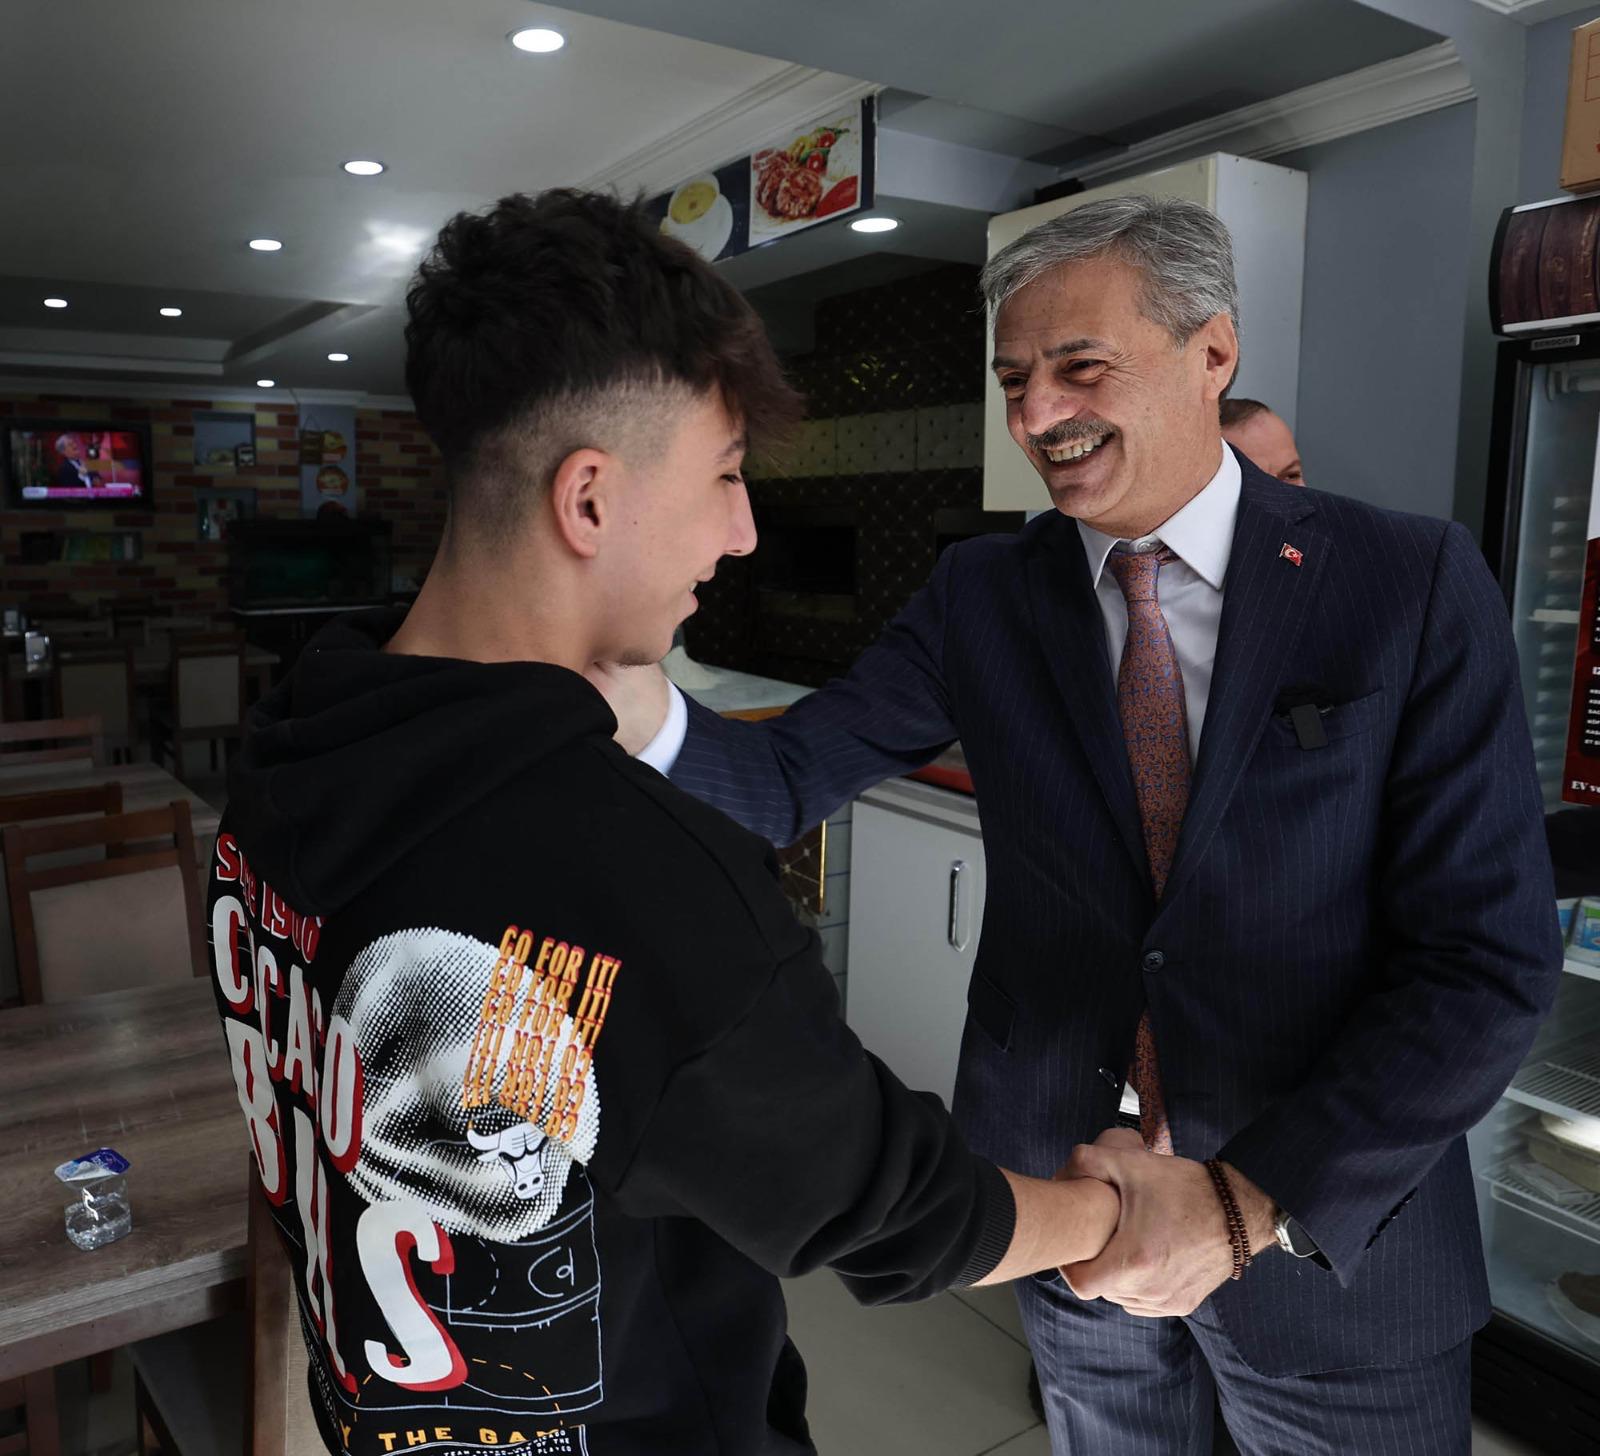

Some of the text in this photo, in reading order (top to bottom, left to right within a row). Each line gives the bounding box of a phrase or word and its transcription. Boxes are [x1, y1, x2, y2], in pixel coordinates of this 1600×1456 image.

[500, 925, 622, 990] GO FOR IT!
[480, 988, 603, 1049] GO FOR IT!
[490, 957, 612, 1021] GO FOR IT!
[378, 1427, 453, 1451] THE
